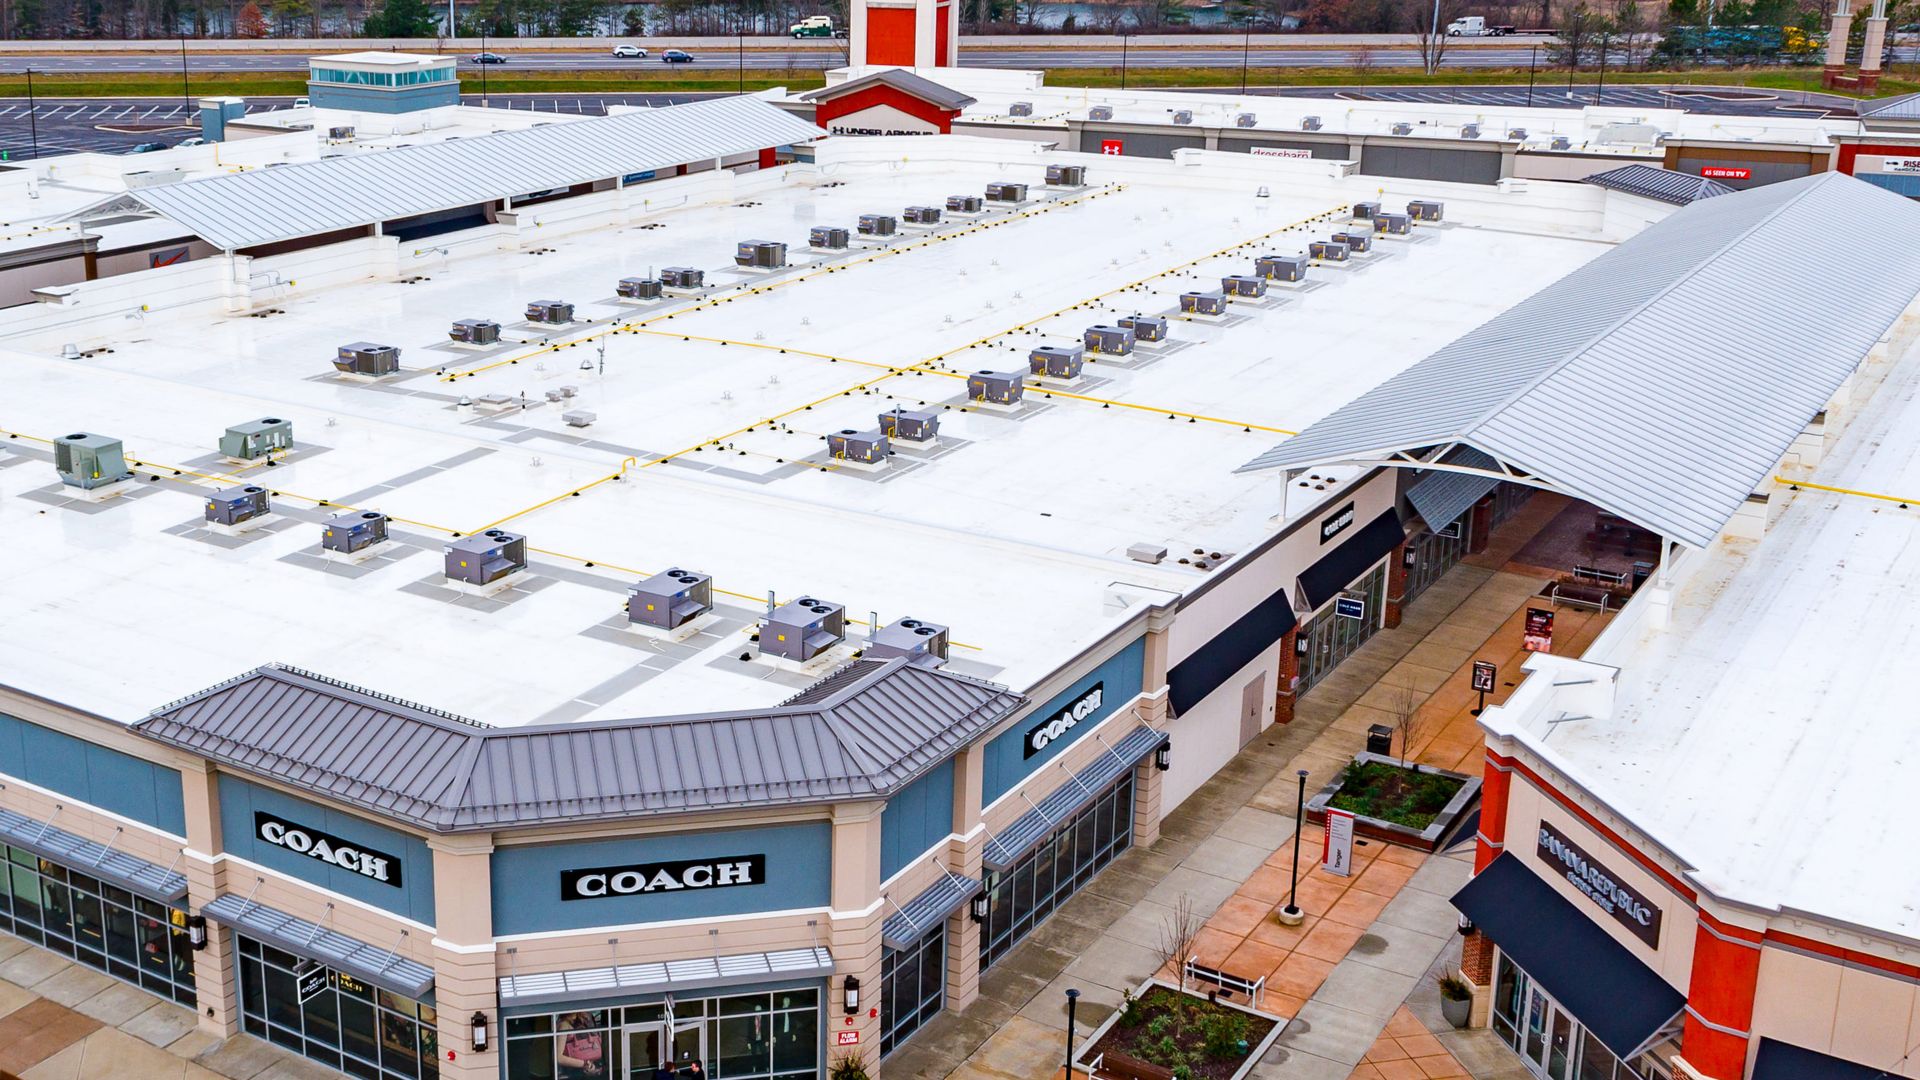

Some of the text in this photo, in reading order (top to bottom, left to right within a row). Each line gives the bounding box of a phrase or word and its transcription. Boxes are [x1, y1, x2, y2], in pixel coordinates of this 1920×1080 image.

[846, 127, 882, 136] UNDER
[1032, 689, 1102, 750] COACH
[261, 821, 389, 882] COACH
[1335, 848, 1343, 869] Tanger
[576, 861, 752, 897] COACH
[1539, 828, 1651, 926] BANANA REPUBLIC
[301, 976, 326, 993] COACH
